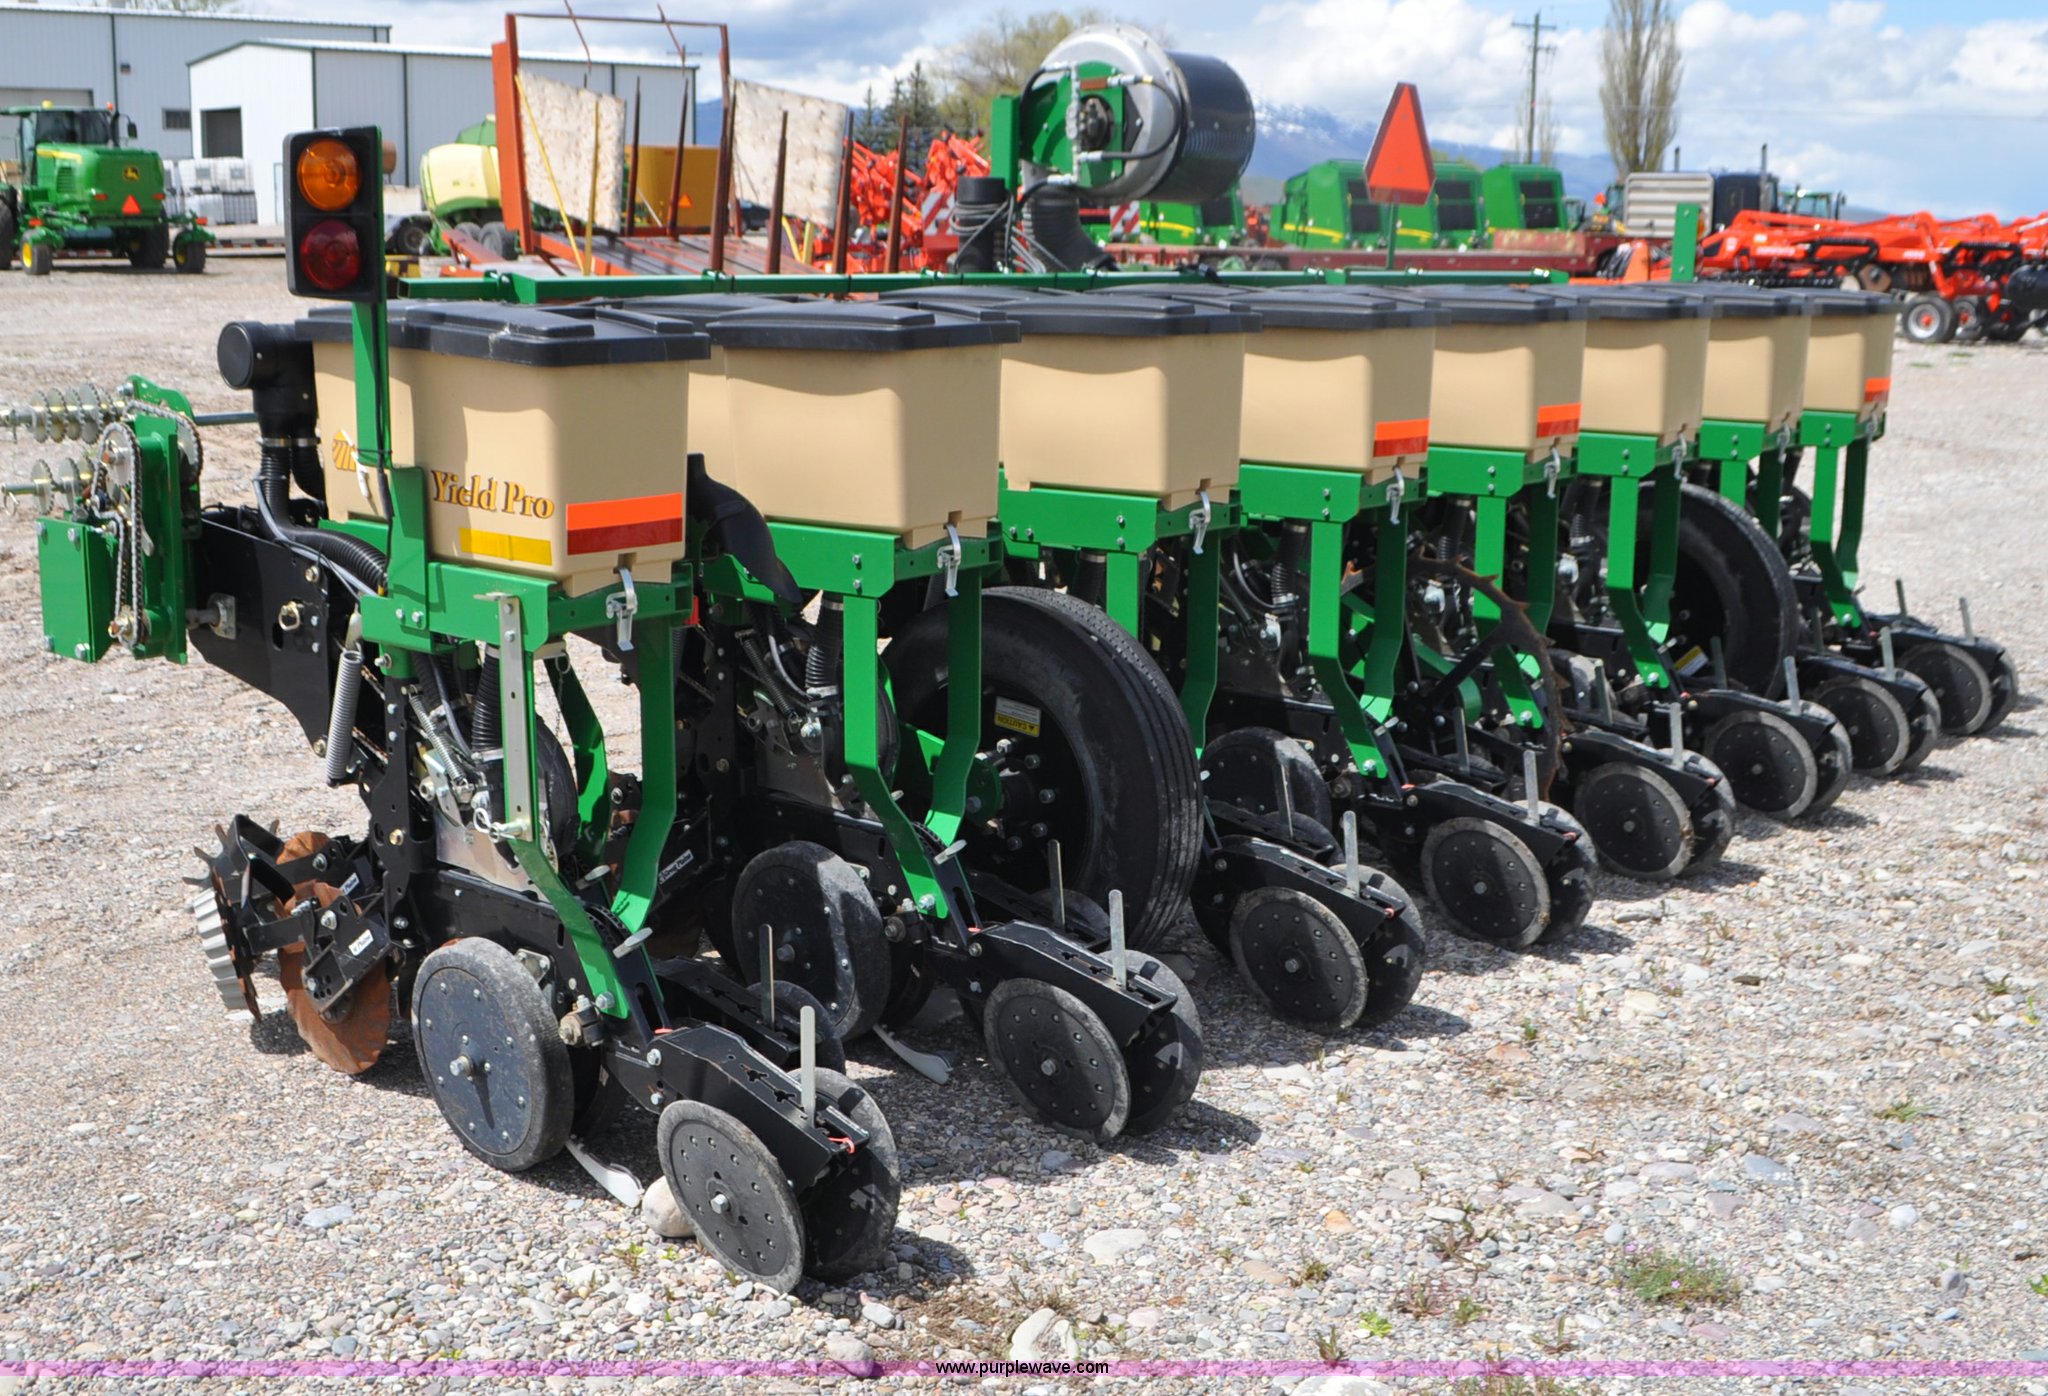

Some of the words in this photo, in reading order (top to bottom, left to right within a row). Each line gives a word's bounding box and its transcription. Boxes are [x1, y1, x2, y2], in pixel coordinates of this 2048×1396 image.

[431, 470, 497, 511] Yield
[501, 481, 555, 518] Pro
[997, 715, 1028, 730] CAUTION
